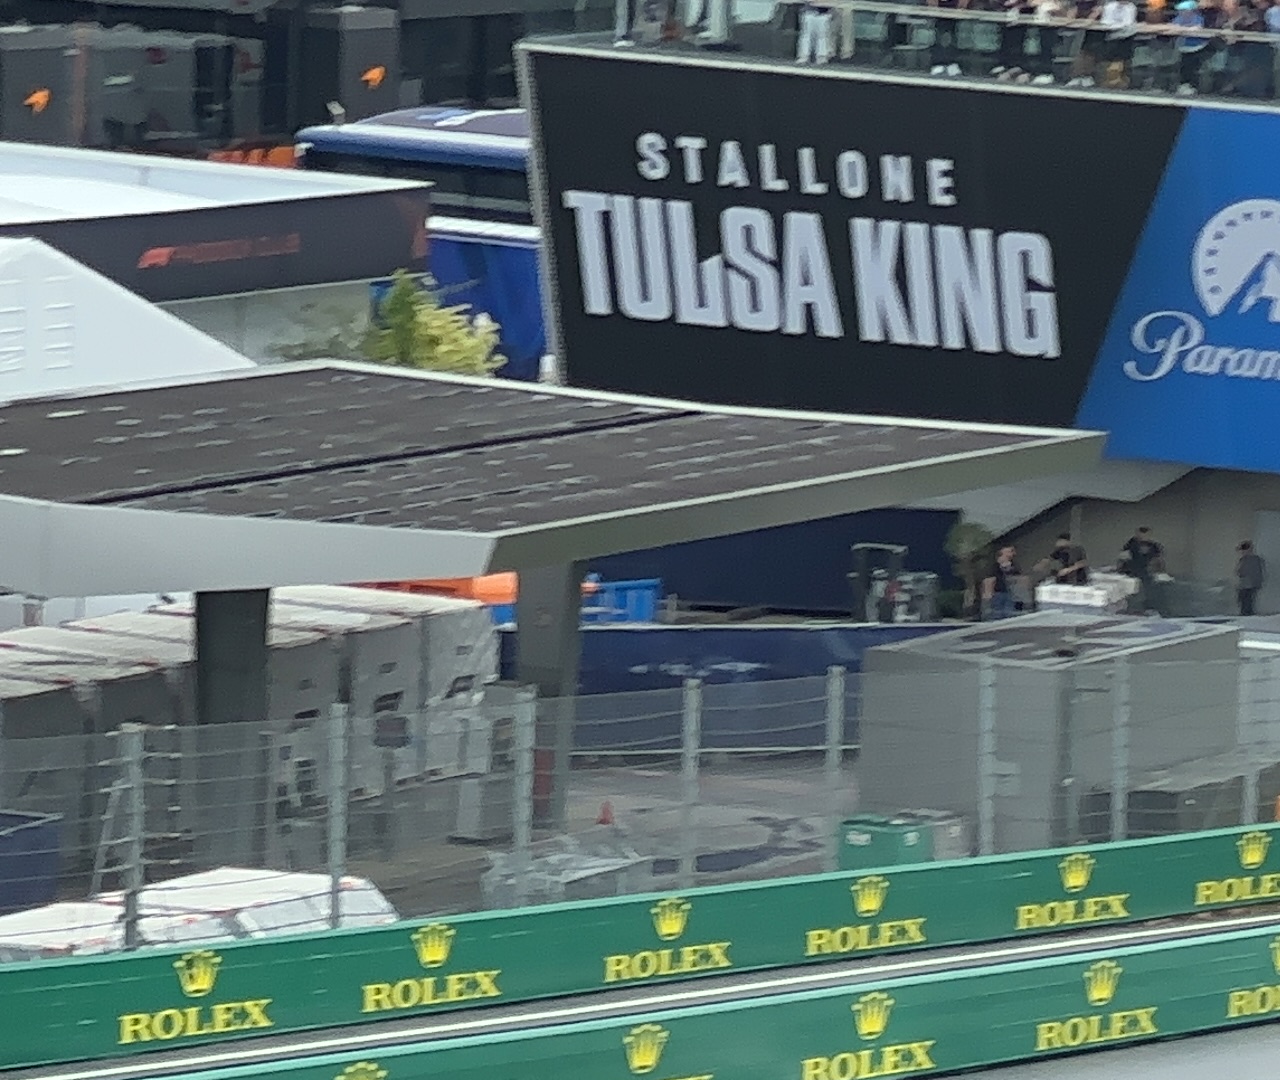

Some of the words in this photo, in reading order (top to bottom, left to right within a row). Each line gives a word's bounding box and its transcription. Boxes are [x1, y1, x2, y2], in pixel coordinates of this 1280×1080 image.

[636, 132, 957, 207] STALLONE
[562, 190, 844, 338] TULSA
[849, 217, 1062, 360] KING
[1016, 893, 1129, 930] ROLEX
[806, 917, 925, 956] ROLEX
[604, 941, 731, 982] ROLEX
[362, 969, 501, 1013] ROLEX
[119, 998, 273, 1045] ROLEX
[1037, 1007, 1157, 1051] ROLEX
